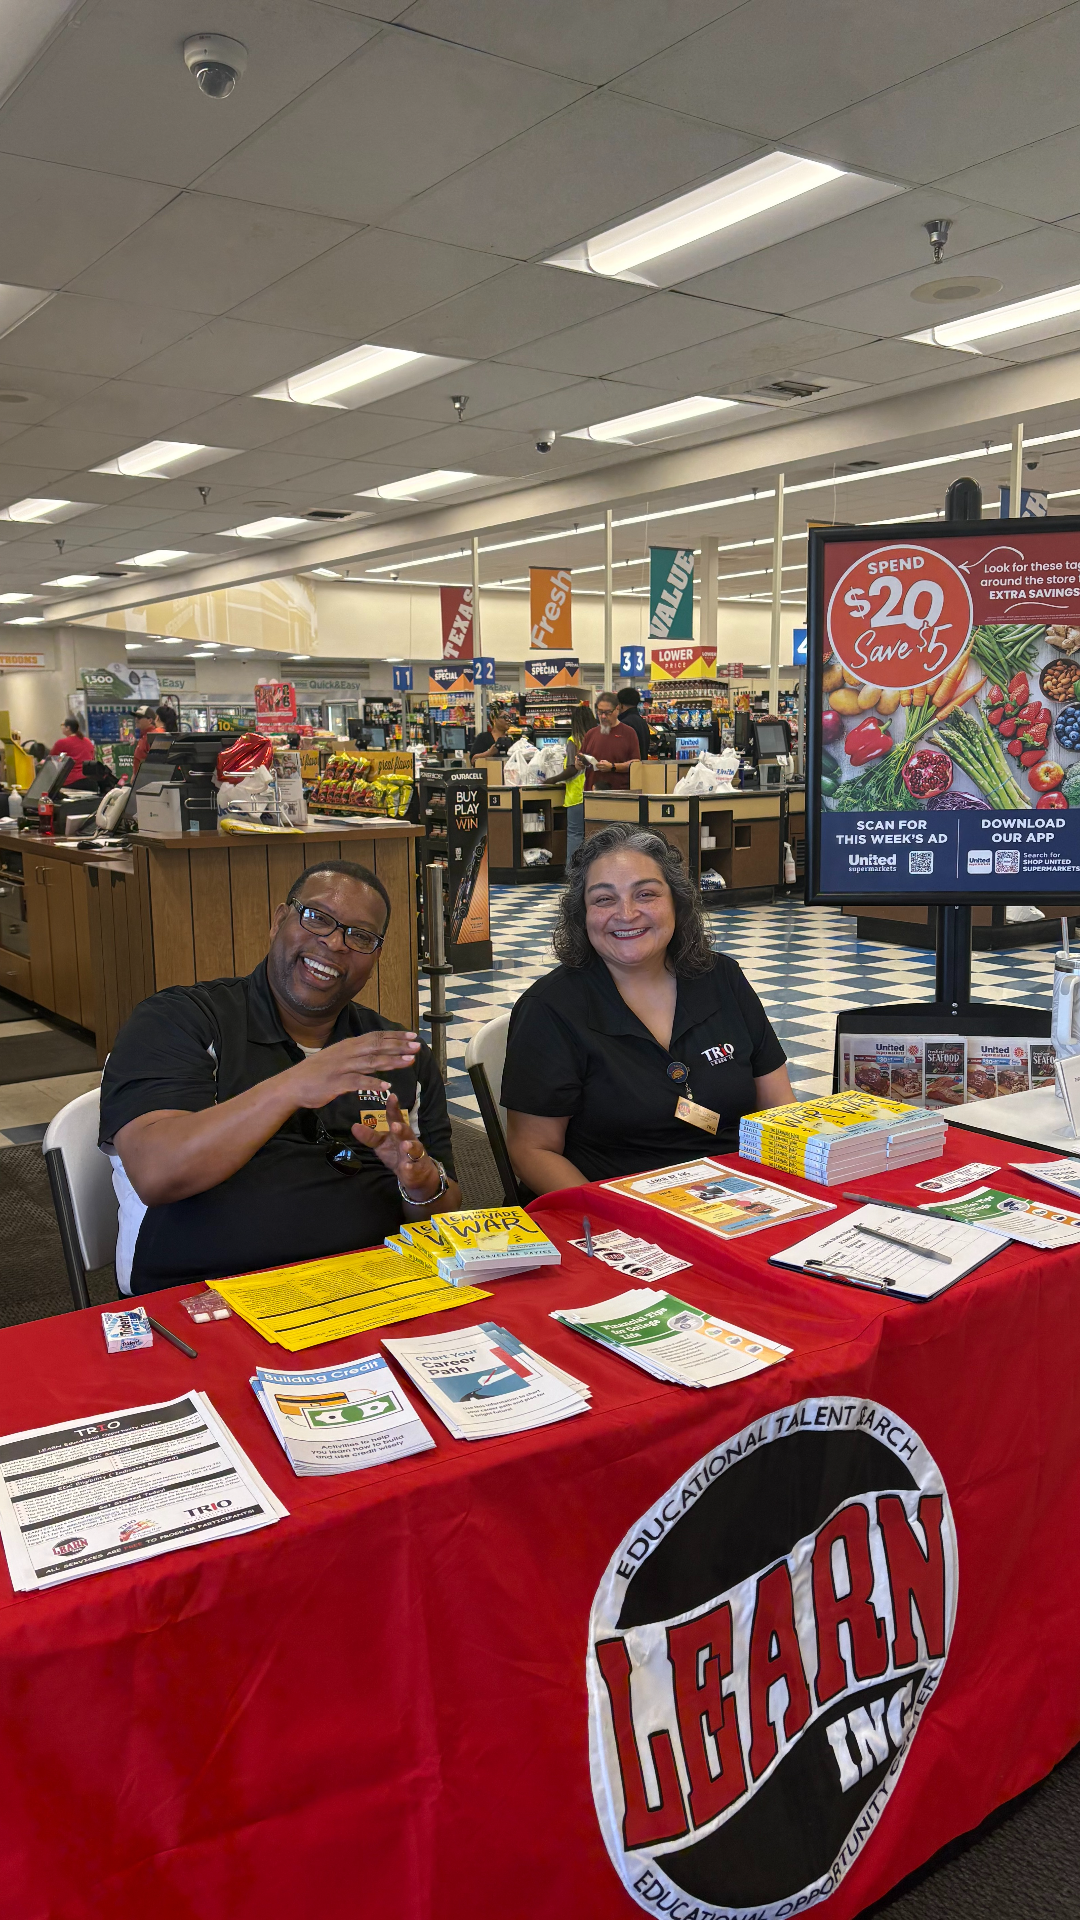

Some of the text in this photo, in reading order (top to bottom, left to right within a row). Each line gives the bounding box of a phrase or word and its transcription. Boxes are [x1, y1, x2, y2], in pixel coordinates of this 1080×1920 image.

[867, 556, 925, 575] SPEND
[984, 562, 1010, 574] Look
[1012, 562, 1028, 572] for
[1031, 561, 1063, 571] these
[980, 574, 1076, 587] around the store
[650, 550, 695, 638] VALUE
[989, 589, 1027, 600] EXTRA
[531, 570, 572, 649] Fresh
[843, 575, 945, 631] $20
[443, 588, 473, 660] TEXAS
[850, 618, 953, 672] Save $5
[622, 651, 632, 671] 3
[635, 651, 643, 671] 3
[658, 649, 694, 662] LOWER
[475, 662, 482, 680] 2
[486, 662, 494, 680] 2
[531, 665, 559, 676] SPECIAL
[664, 661, 687, 669] PRICE
[84, 675, 114, 684] 1,500
[395, 670, 400, 686] 1
[405, 670, 411, 686] 1
[434, 670, 458, 681] SPECIAL
[309, 681, 361, 691] Quick&Easy
[680, 738, 700, 746] United
[450, 772, 483, 781] DURACELL
[456, 790, 478, 803] BUY
[492, 796, 498, 804] 3
[454, 802, 480, 816] PLAY
[455, 817, 478, 830] WIN
[856, 819, 927, 831] SCAN FOR
[981, 818, 1066, 829] DOWNLOAD
[835, 832, 948, 845] THIS WEEK'S AD
[991, 832, 1055, 843] OUR APP
[848, 853, 897, 866] United
[848, 865, 897, 873] supermarkets
[875, 1043, 905, 1052] United
[981, 1045, 1010, 1054] United
[927, 1053, 960, 1063] SEAFOOD
[1033, 1055, 1055, 1065] SEAFO
[440, 1210, 523, 1226] LEMONADE
[449, 1217, 539, 1238] WAR
[600, 1307, 668, 1330] Financial Tips
[626, 1319, 661, 1332] College
[415, 1349, 478, 1363] Chart Your
[421, 1356, 476, 1369] Career
[263, 1361, 380, 1384] Building Credit
[429, 1365, 470, 1377] Path
[73, 1420, 121, 1437] TRIO
[321, 1441, 360, 1450] Activities
[371, 1434, 390, 1443] help
[328, 1447, 351, 1455] learn
[383, 1434, 405, 1445] build
[352, 1448, 377, 1457] credit
[378, 1441, 404, 1452] wisely
[616, 1405, 919, 1580] EDUCATIONAL TALENT SEARCH
[183, 1499, 232, 1518] TRIO
[45, 1566, 61, 1574] ALL
[63, 1553, 104, 1569] SERVICES
[106, 1547, 122, 1556] ARE
[160, 1526, 196, 1541] PROGRAM
[197, 1509, 255, 1529] PARTICIPANTS!
[52, 1538, 89, 1556] LEARN
[595, 1495, 945, 1853] LEARN
[775, 1780, 890, 1918] OPPORTUNITY
